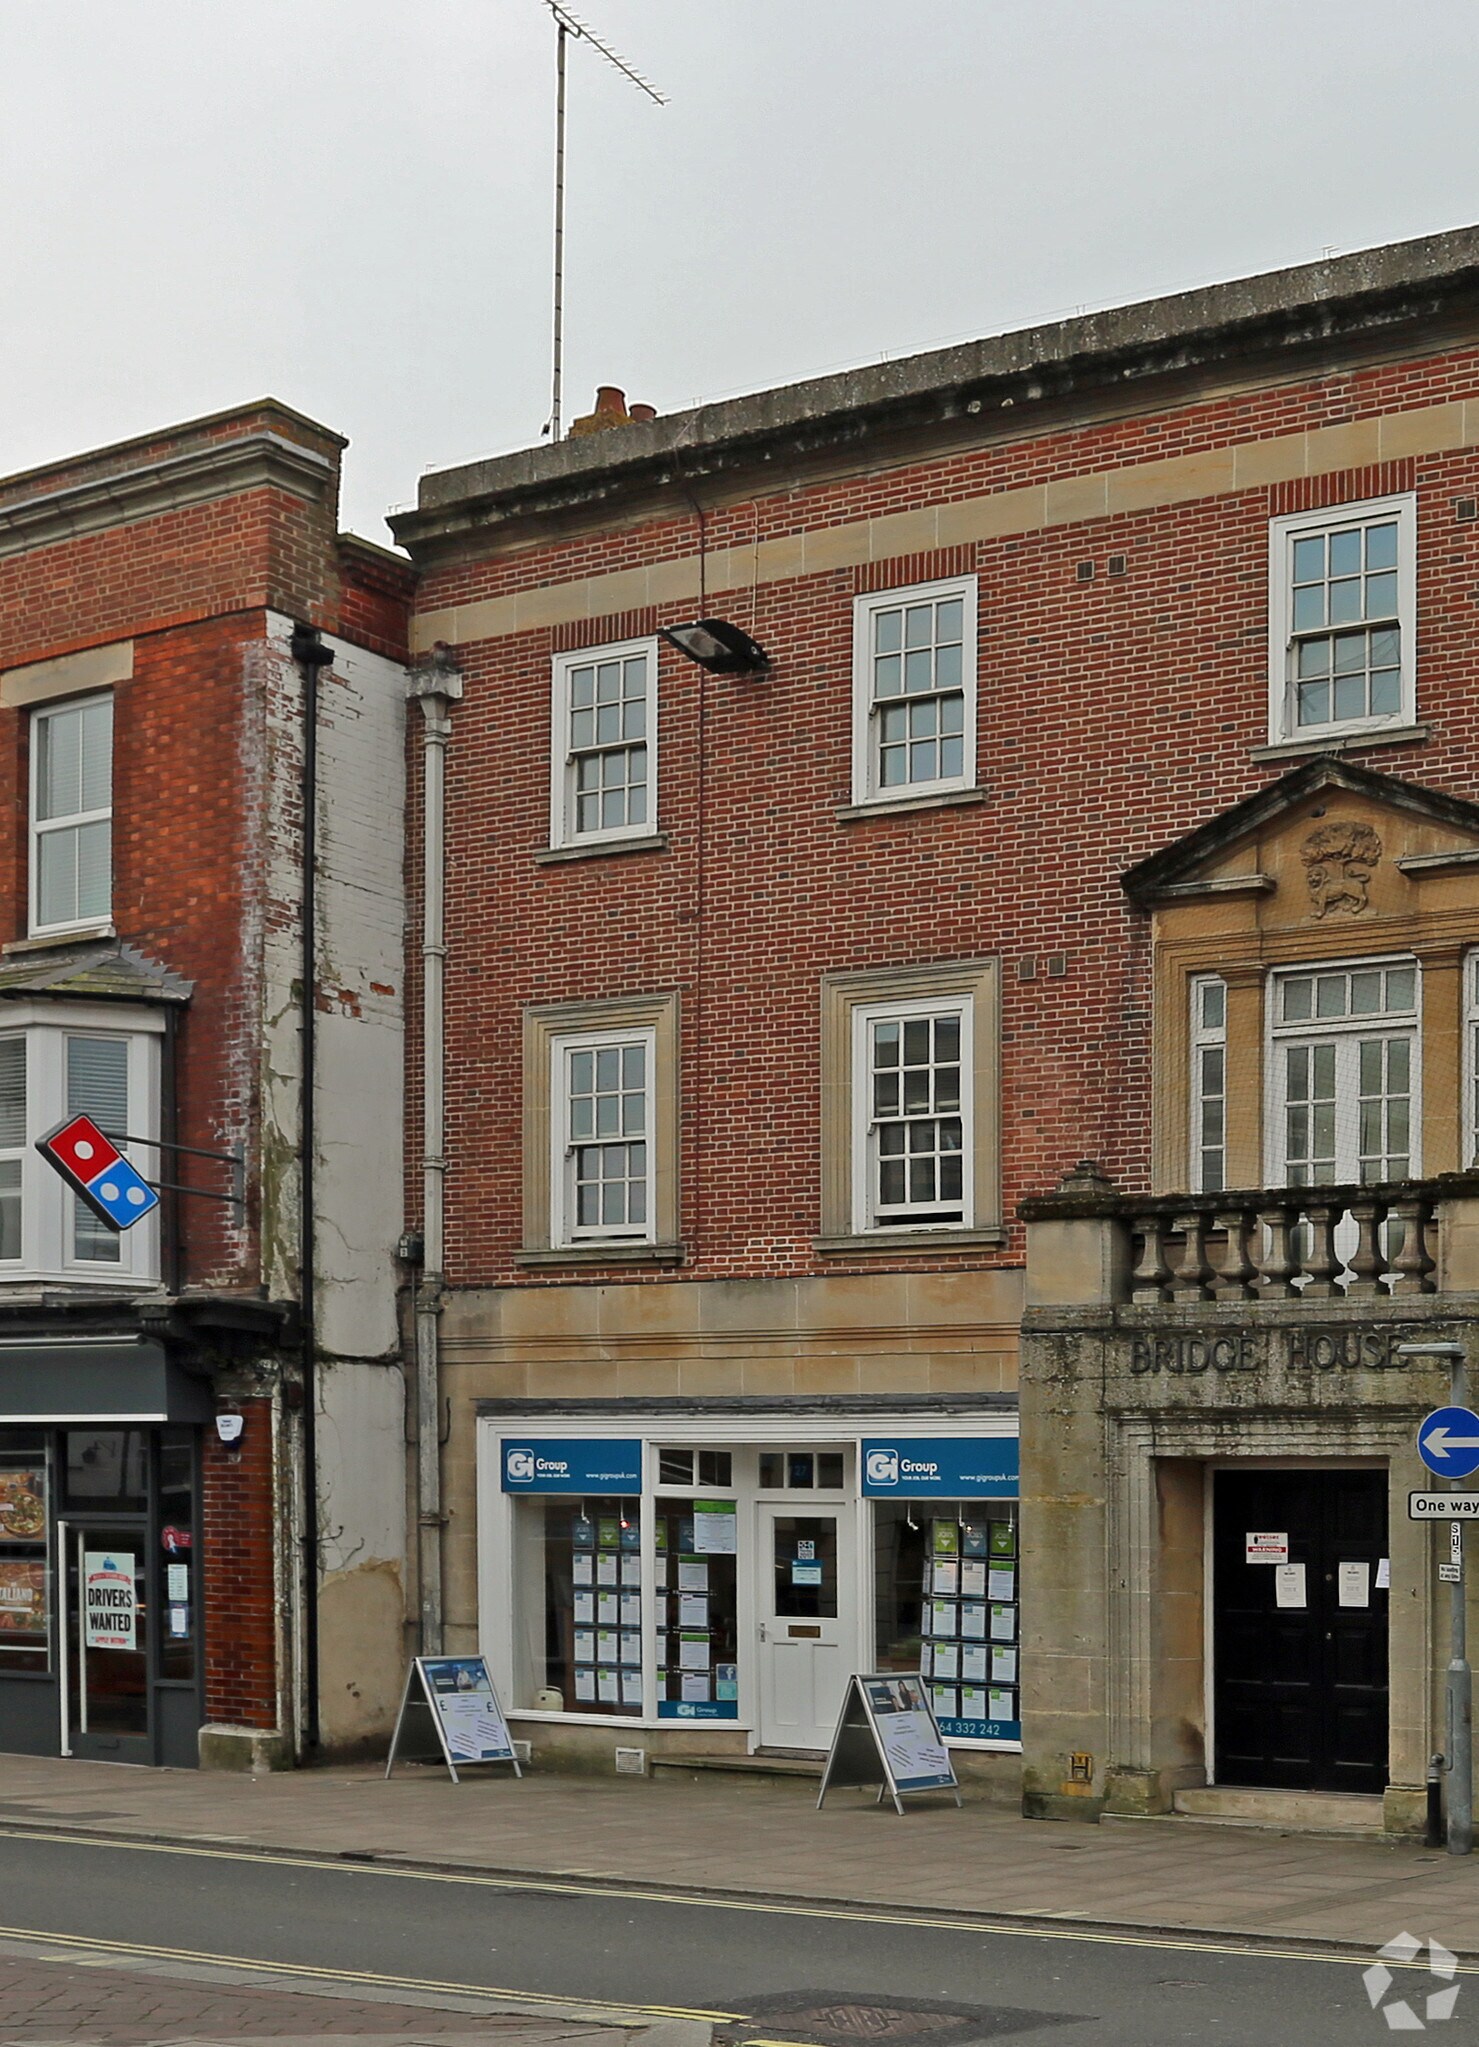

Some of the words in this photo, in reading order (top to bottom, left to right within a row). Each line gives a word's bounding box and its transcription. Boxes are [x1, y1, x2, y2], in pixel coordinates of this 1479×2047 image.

[1130, 1336, 1258, 1373] BRIDGE
[1287, 1334, 1408, 1370] HOUSE
[508, 1452, 534, 1478] Gi
[536, 1458, 567, 1473] Group
[867, 1452, 898, 1481] Gi
[901, 1459, 937, 1475] Group
[586, 1472, 637, 1481] www.gigroupuk.com
[1416, 1499, 1446, 1511] One
[1451, 1502, 1479, 1514] way
[88, 1588, 133, 1608] DRIVERS
[89, 1612, 131, 1632] WANTED
[955, 1722, 976, 1734] 332
[979, 1724, 1000, 1736] 242
